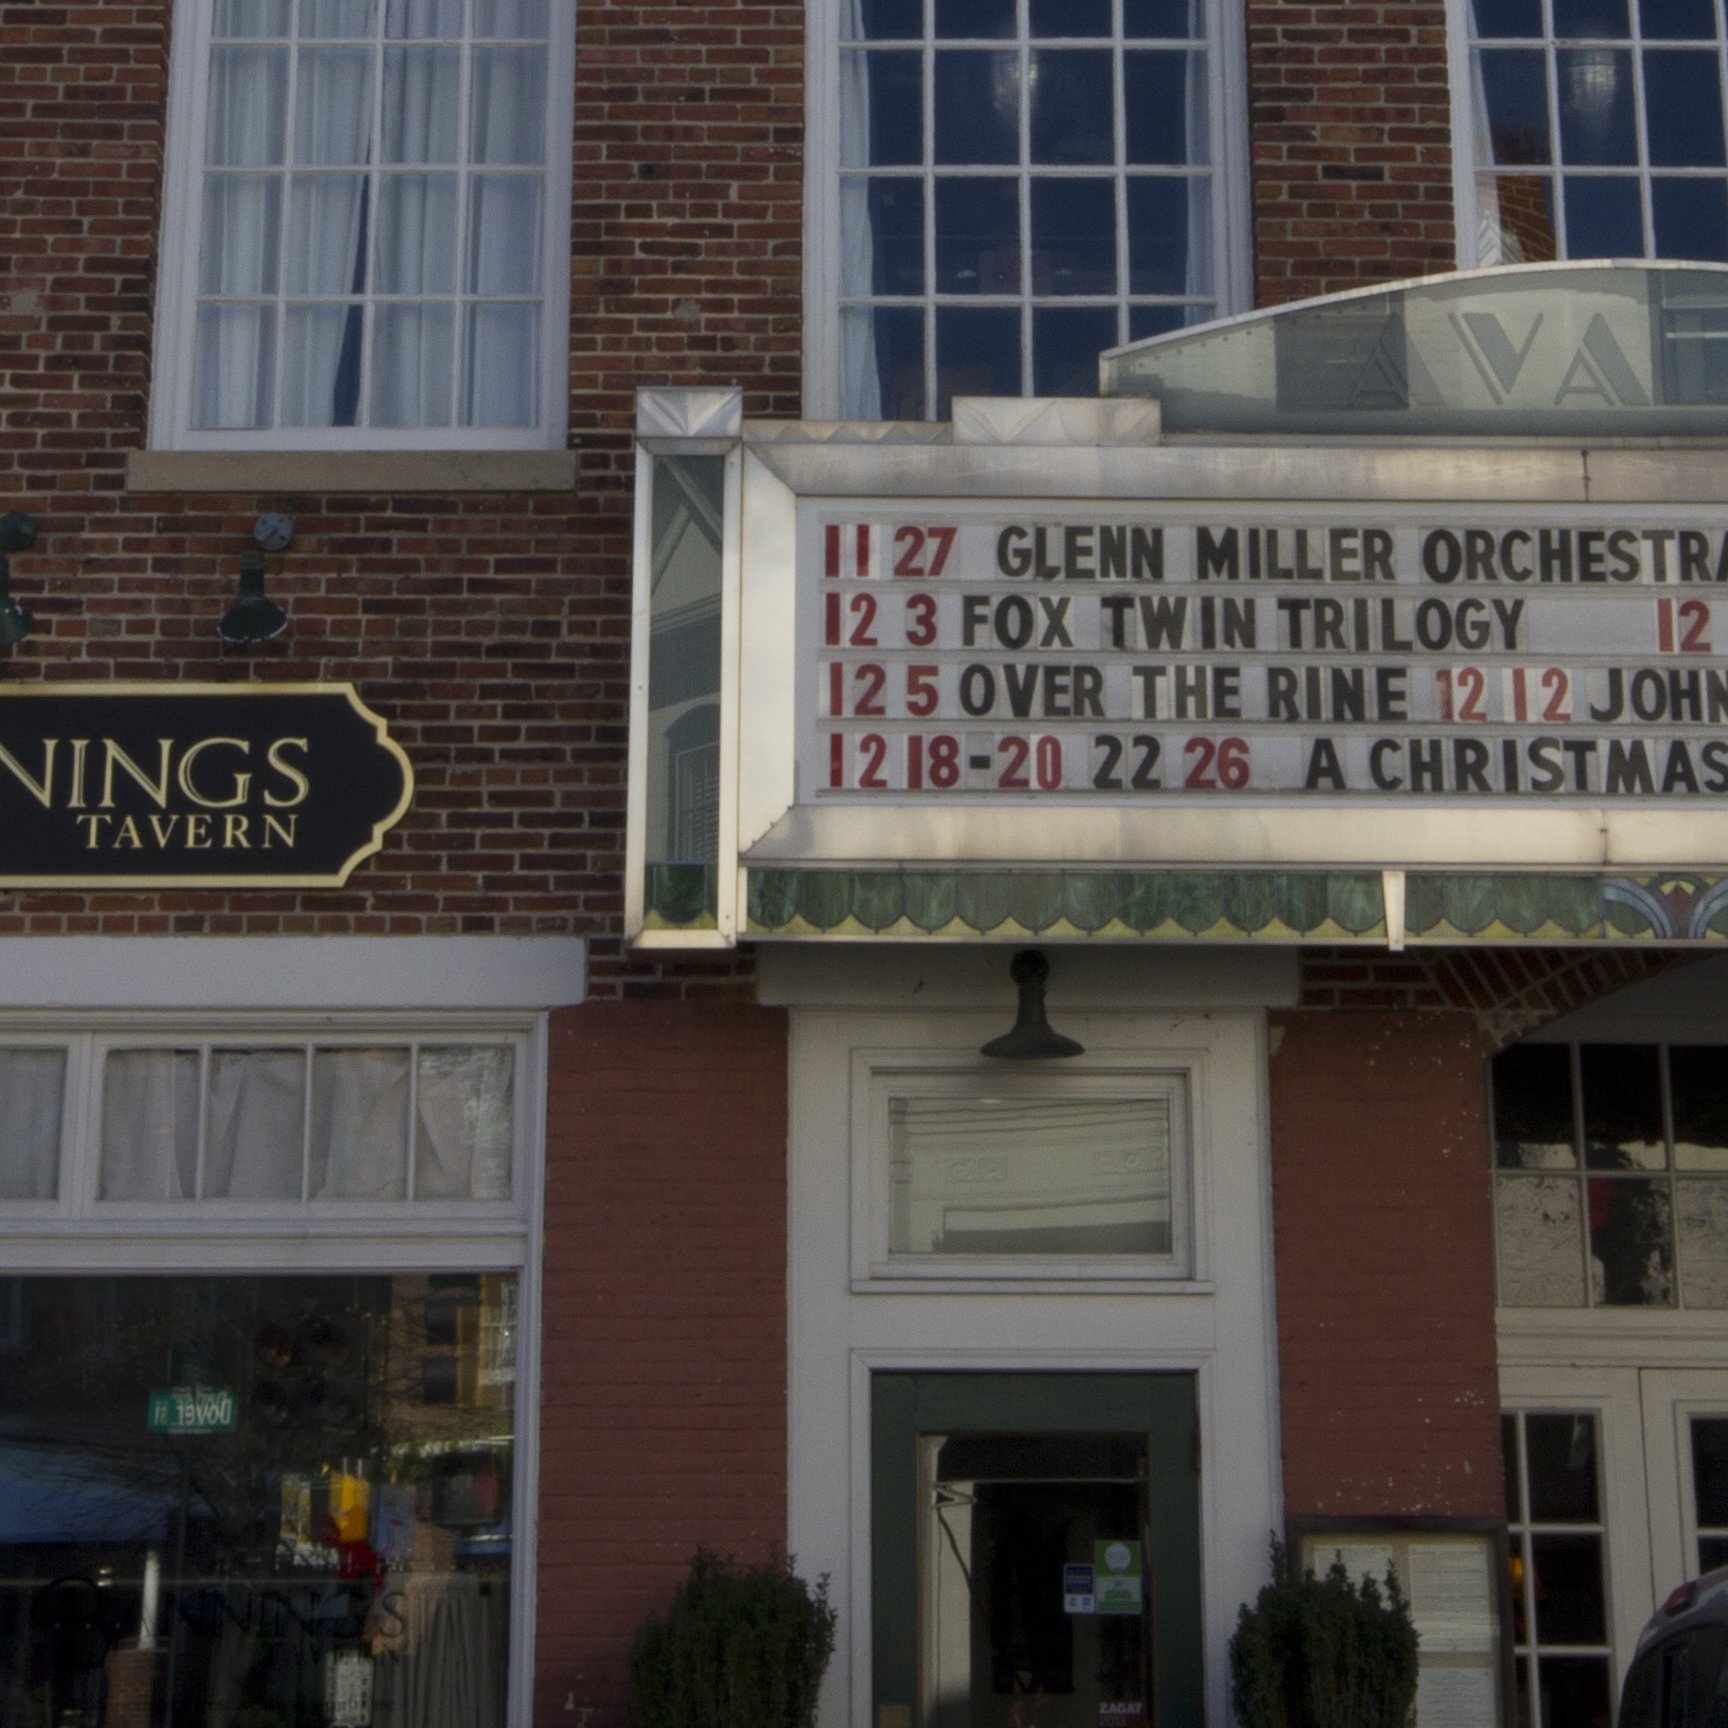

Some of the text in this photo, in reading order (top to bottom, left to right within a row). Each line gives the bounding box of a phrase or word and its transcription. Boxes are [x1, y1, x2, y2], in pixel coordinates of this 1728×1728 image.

[894, 525, 957, 577] 27
[997, 525, 1163, 584] GLENN
[1197, 526, 1395, 581] MILLER
[826, 592, 877, 646] 12
[906, 593, 937, 646] 3
[963, 594, 1072, 652] FOX
[1101, 593, 1256, 653] TWIN
[1277, 596, 1524, 655] TRILOGY
[1658, 599, 1710, 652] 12
[830, 662, 886, 716] 12
[907, 665, 938, 716] 5
[960, 663, 1108, 723] OVER
[1133, 665, 1243, 723] THE
[1265, 666, 1407, 725] RINE
[1437, 668, 1486, 725] 12
[1514, 669, 1570, 721] 12
[830, 733, 887, 791] 12
[1094, 736, 1161, 791] 22
[1186, 738, 1250, 790] 26
[1305, 739, 1347, 792] A
[77, 814, 299, 849] TAVERN
[1099, 1702, 1143, 1714] ZAGAT
